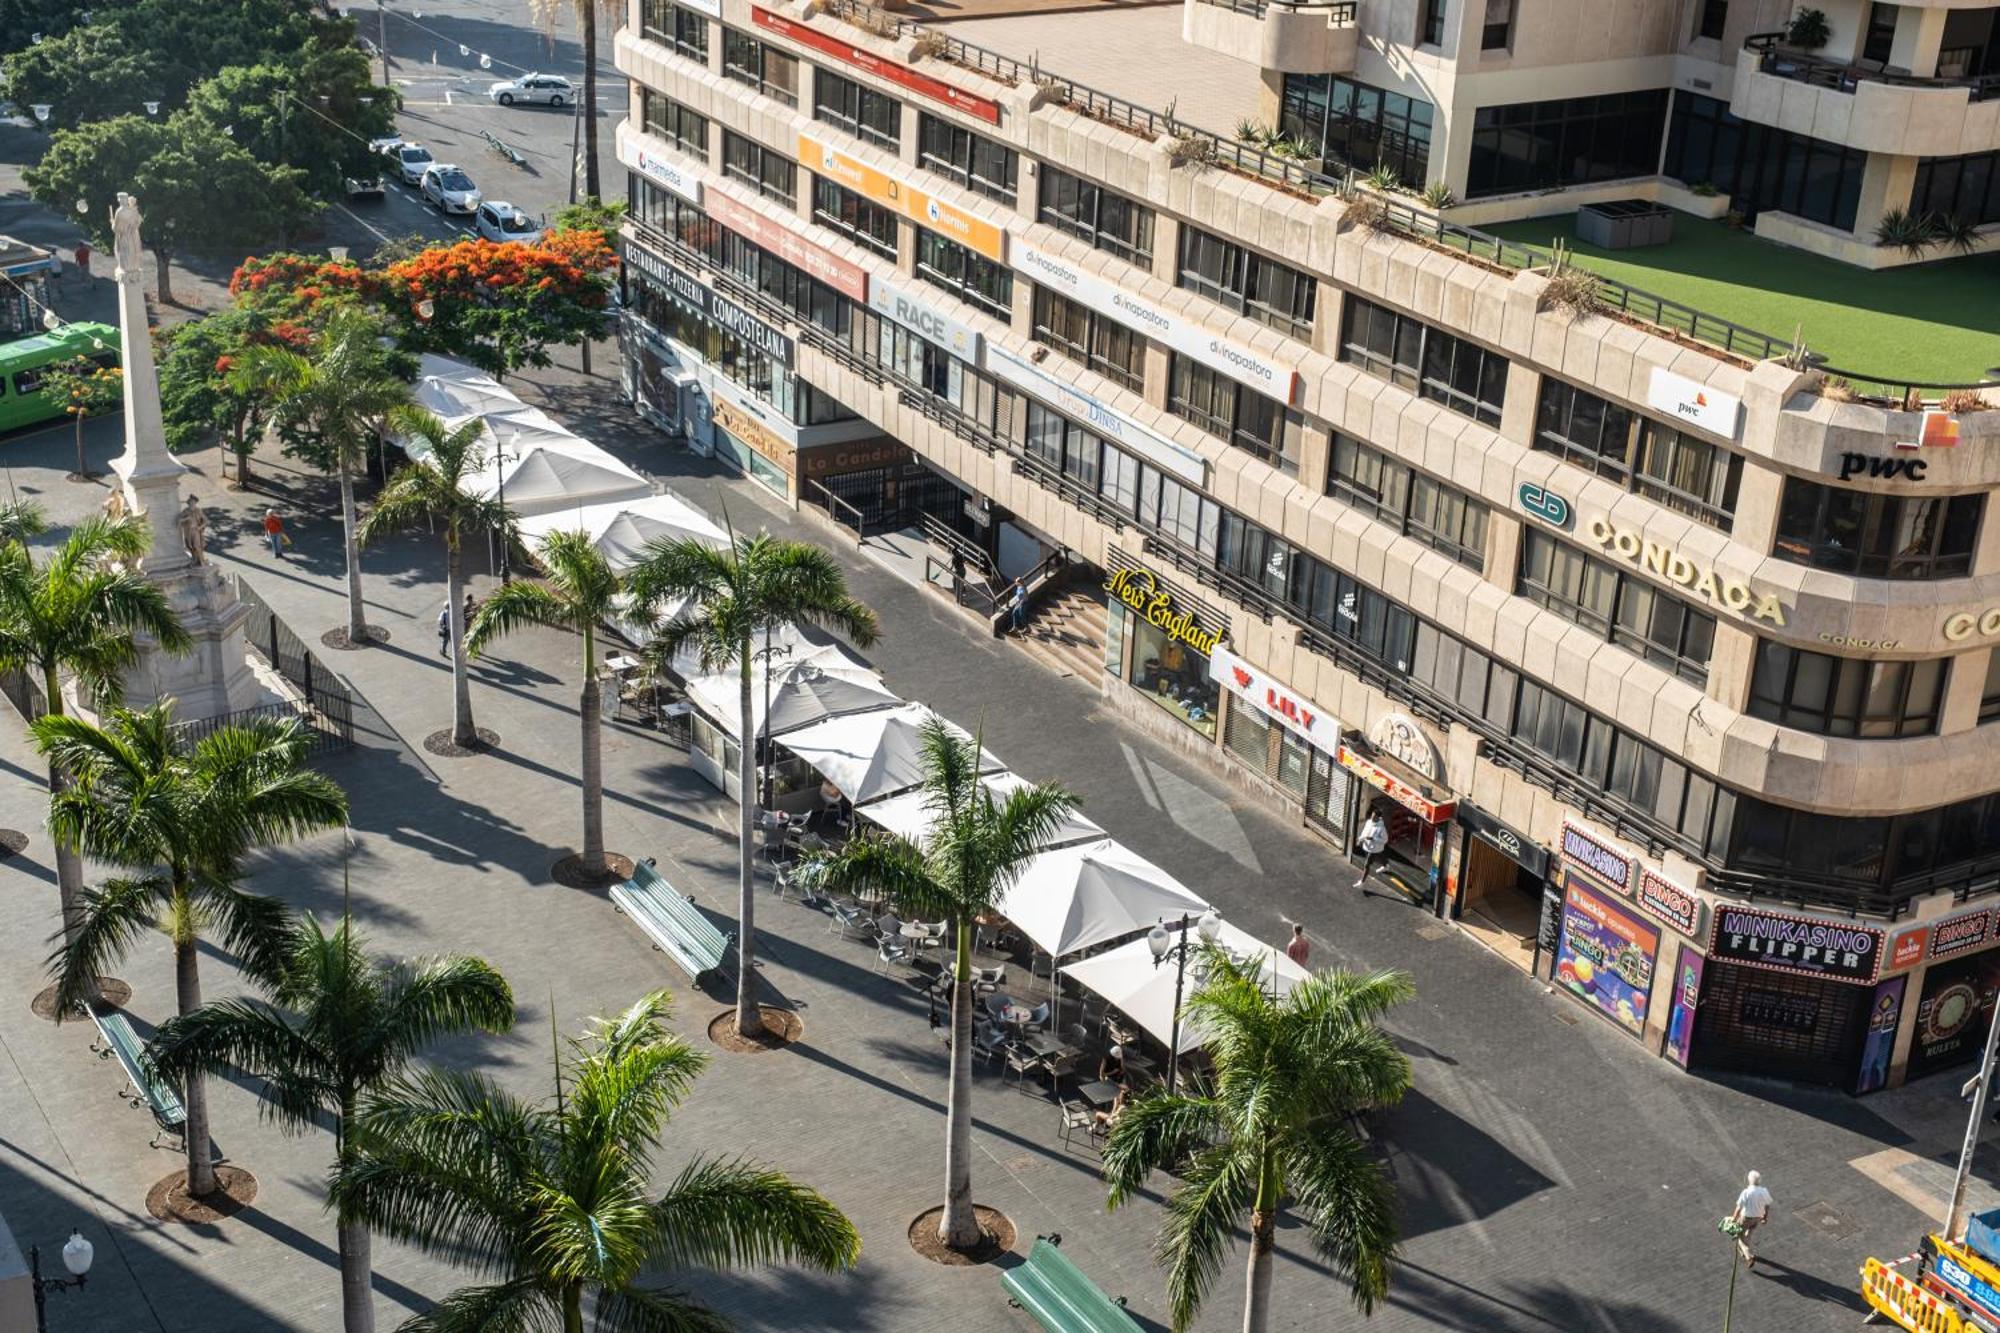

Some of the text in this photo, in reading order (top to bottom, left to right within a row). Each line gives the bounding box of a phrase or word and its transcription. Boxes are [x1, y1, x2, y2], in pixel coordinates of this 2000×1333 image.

[712, 295, 786, 362] COMPOSTELANA
[896, 296, 945, 342] RACE
[1678, 402, 1699, 417] pwc
[1837, 451, 1928, 482] pwc
[1102, 569, 1224, 656] New England
[1266, 687, 1316, 733] LILY
[1645, 877, 1692, 918] BINGO
[1724, 912, 1872, 954] MINIKASINO
[1938, 917, 1985, 944] BINGO
[1730, 935, 1860, 968] FLIPPER
